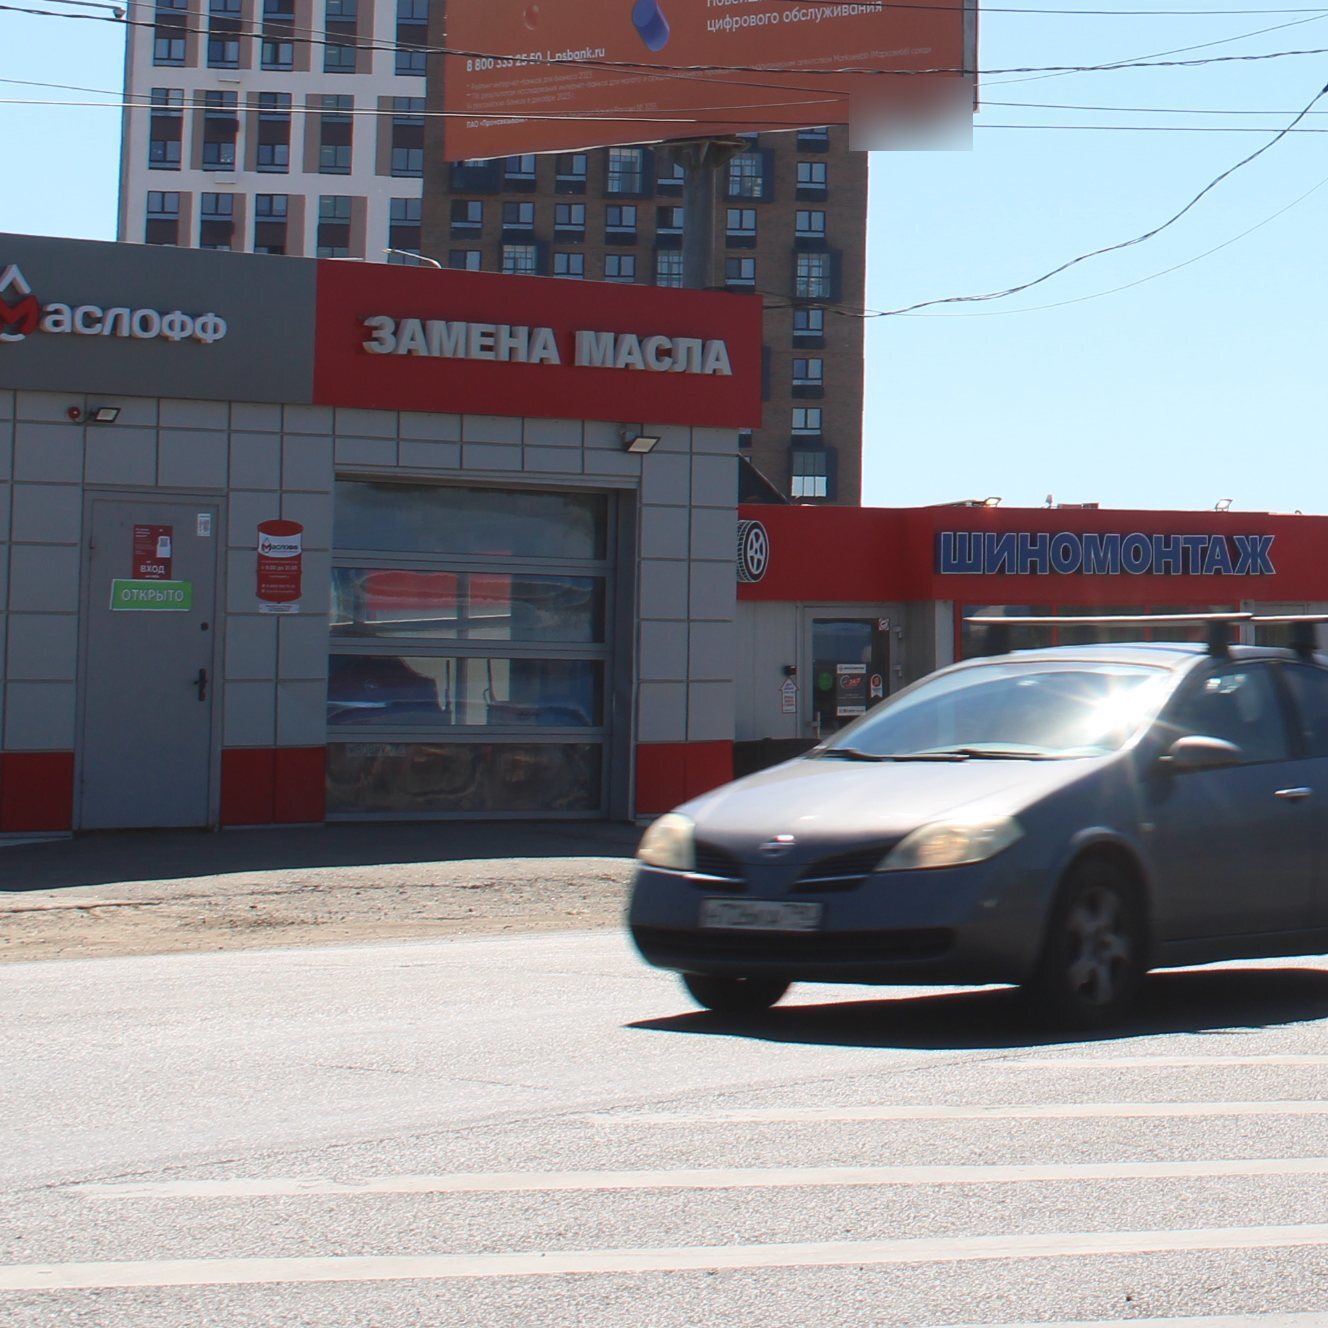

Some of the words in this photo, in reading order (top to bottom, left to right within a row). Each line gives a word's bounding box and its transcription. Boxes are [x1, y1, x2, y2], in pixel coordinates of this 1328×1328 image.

[707, 10, 779, 33] цифрового
[783, 0, 883, 23] обслуживания
[466, 60, 473, 72] 8
[474, 58, 494, 71] 800
[555, 47, 606, 63] psbank.ru
[0, 294, 228, 344] Маслофф
[362, 315, 561, 365] ЗАМЕНА
[573, 330, 732, 376] МАСЛА
[140, 565, 165, 574] ВХОД
[940, 531, 1276, 576] ШИНОМОНТАЖ
[121, 588, 184, 602] ОТКРЫТО
